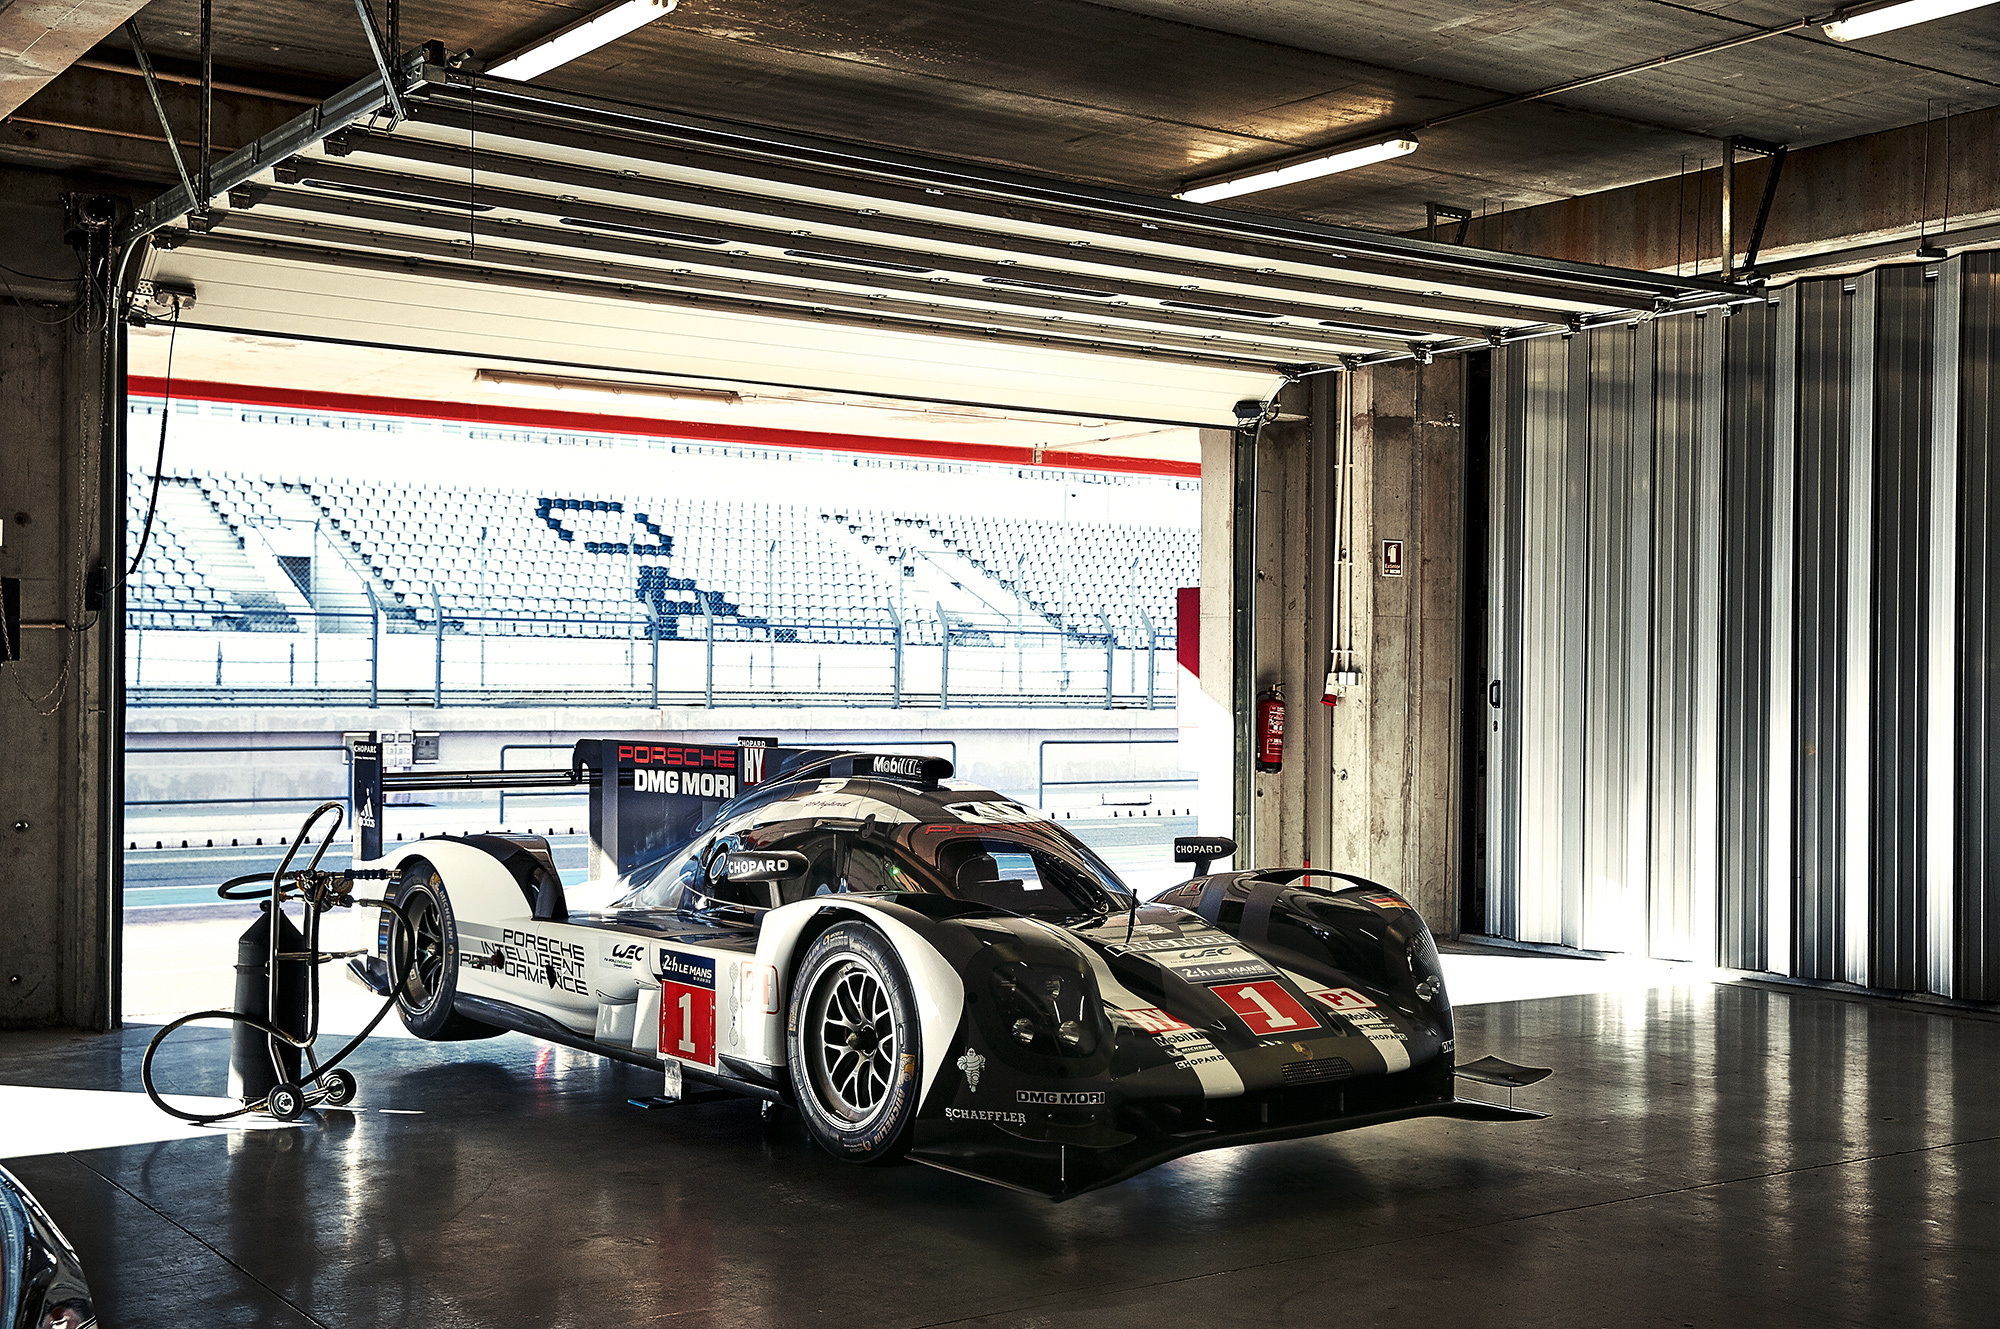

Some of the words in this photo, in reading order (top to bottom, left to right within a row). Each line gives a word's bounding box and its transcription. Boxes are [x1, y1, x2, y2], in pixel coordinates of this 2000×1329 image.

[619, 746, 735, 768] PORSCHE
[744, 748, 765, 783] HY
[873, 756, 905, 774] Mobil
[634, 769, 679, 794] DMG
[682, 772, 736, 798] MORI
[1176, 845, 1222, 853] CHOPARD
[728, 860, 789, 874] CHOPARD
[440, 890, 454, 940] MICHELIN
[503, 929, 585, 961] PORSCHE
[481, 941, 585, 979] INTELLIGENT
[460, 953, 589, 996] PEORMNCE
[679, 963, 689, 974] LE
[689, 965, 713, 979] MANS
[1228, 964, 1265, 974] MANS
[1237, 986, 1298, 1028] 1
[1319, 991, 1366, 1007] P1
[678, 992, 696, 1054] 1
[1120, 1009, 1183, 1032] HY
[1342, 1011, 1377, 1021] Mobil
[1153, 1033, 1191, 1047] Mobil
[1368, 1033, 1407, 1041] CHOPARD
[1182, 1043, 1214, 1053] MICHELIN
[1177, 1055, 1225, 1069] CHOPARD
[1017, 1091, 1058, 1104] DMG
[1060, 1092, 1105, 1105] MORI
[874, 1088, 906, 1145] MICHELIN
[945, 1107, 1026, 1123] SCHAEFFLER
